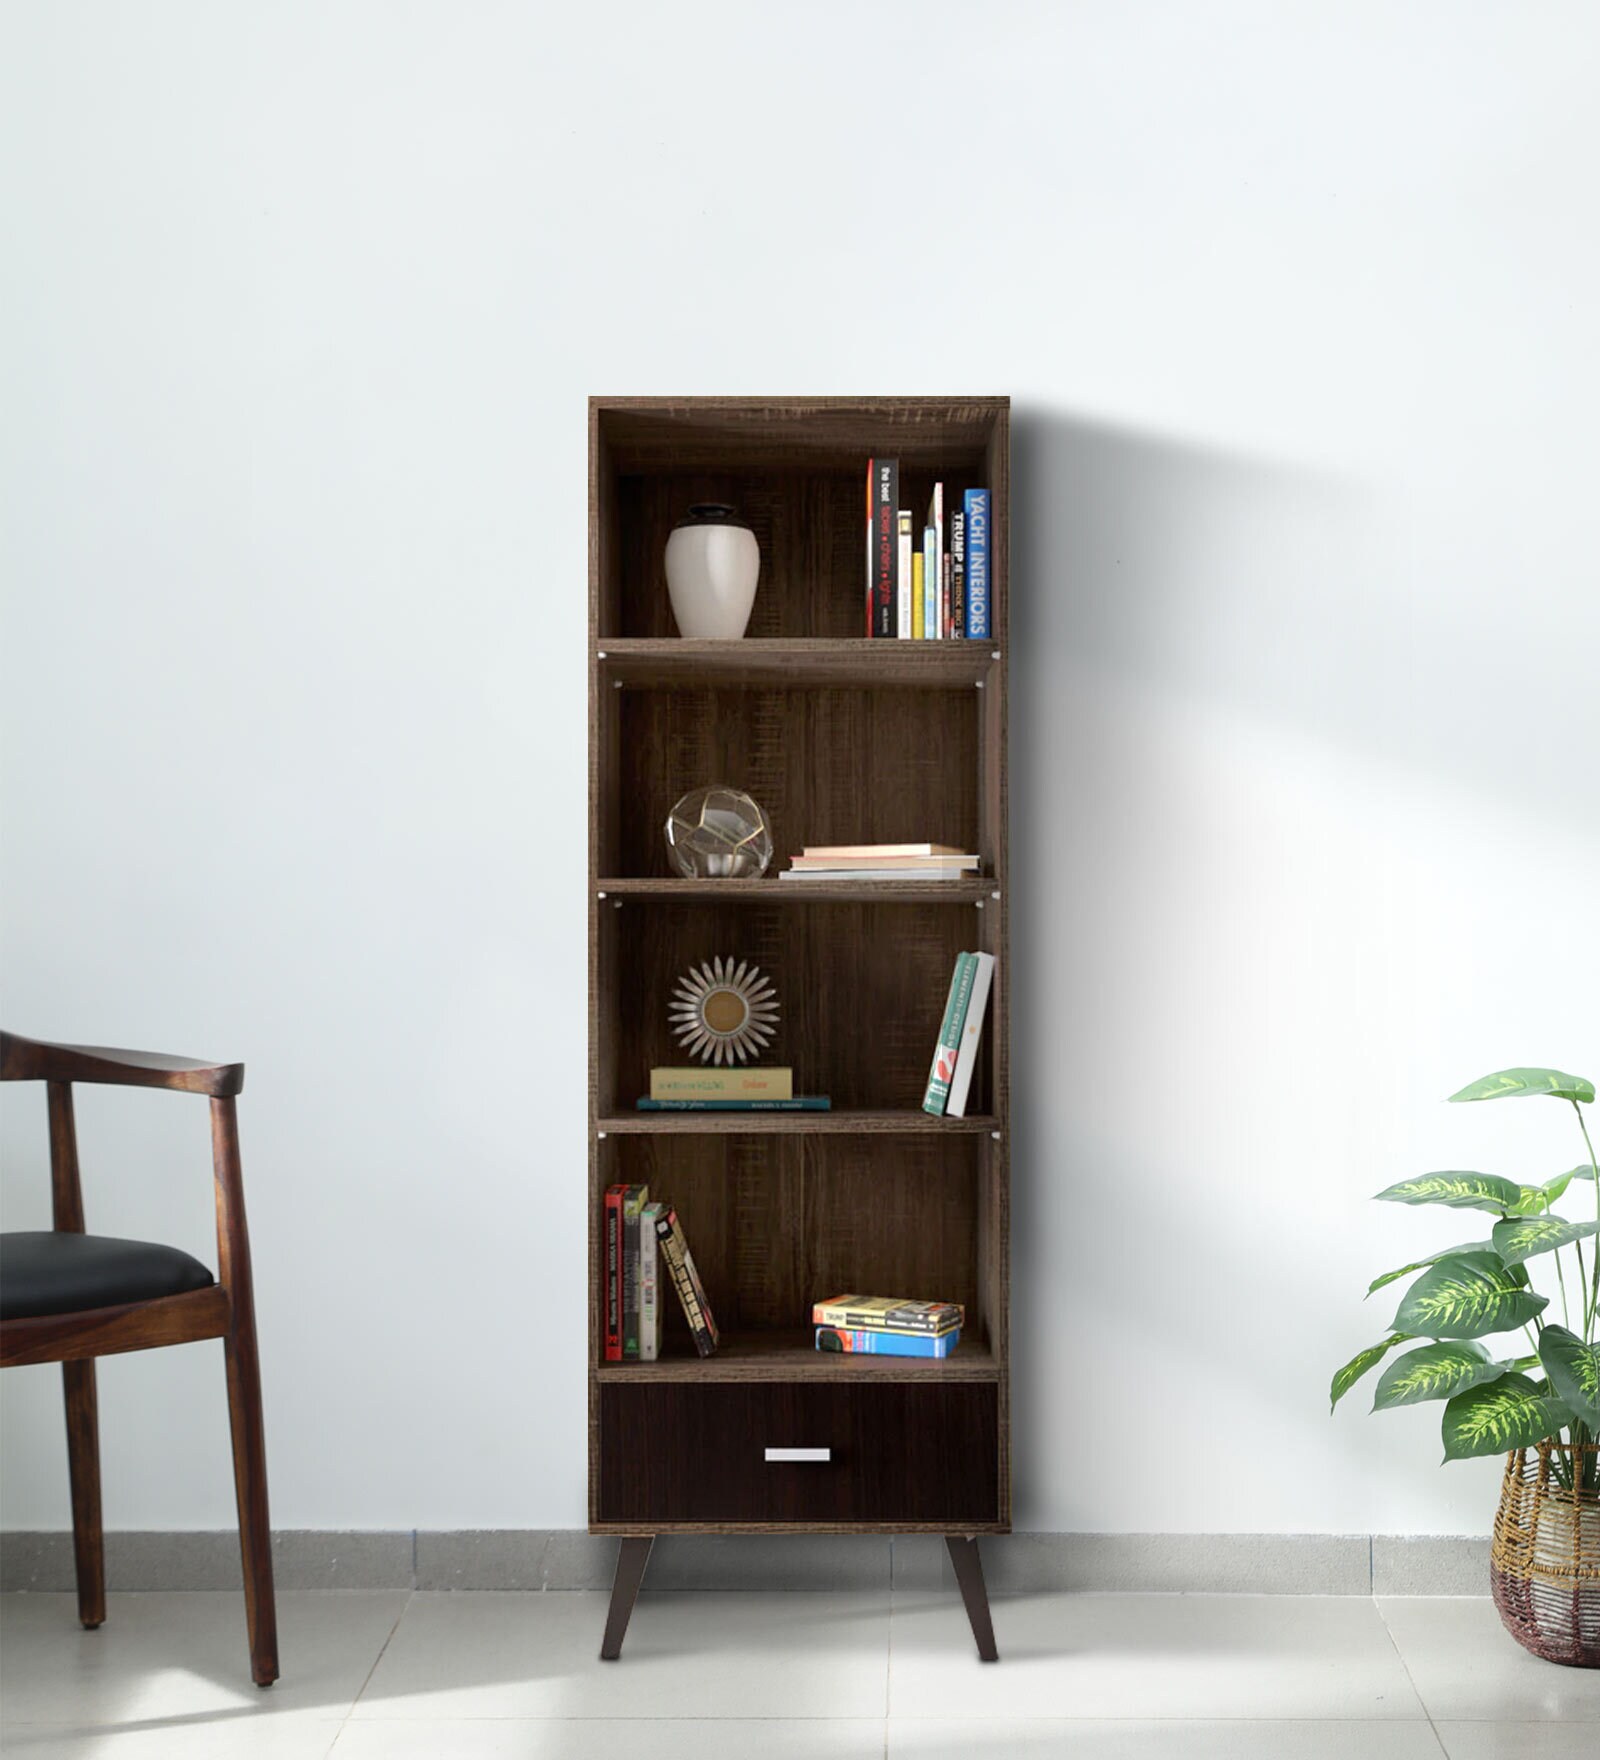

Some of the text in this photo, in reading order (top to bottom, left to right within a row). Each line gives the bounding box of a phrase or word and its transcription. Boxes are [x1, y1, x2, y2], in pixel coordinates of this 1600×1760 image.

[881, 467, 891, 481] the
[881, 483, 891, 502] best
[954, 512, 964, 562] TRUMP
[970, 494, 985, 634] YACHT INTERIORS
